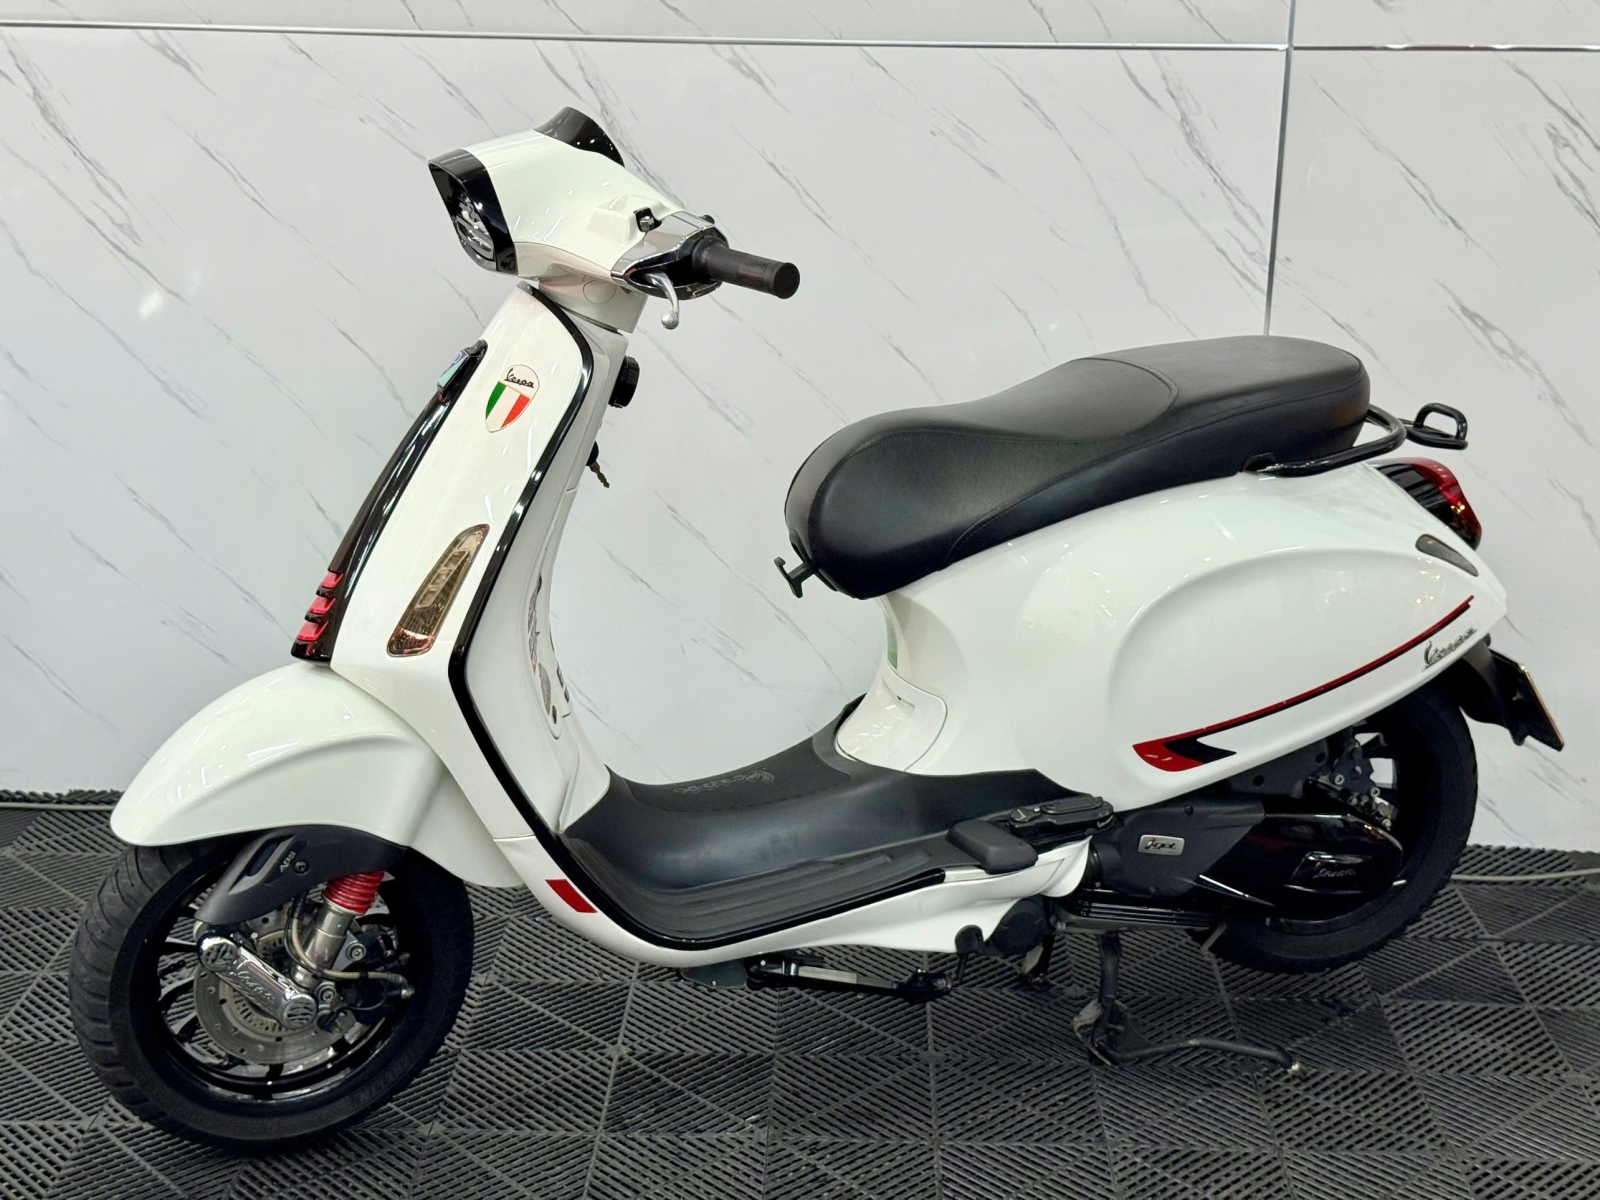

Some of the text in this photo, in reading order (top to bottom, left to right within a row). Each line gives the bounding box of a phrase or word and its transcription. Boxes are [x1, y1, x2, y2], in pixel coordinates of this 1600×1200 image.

[503, 367, 535, 389] Vespa
[1421, 626, 1477, 672] Vespa
[279, 850, 296, 873] ABS
